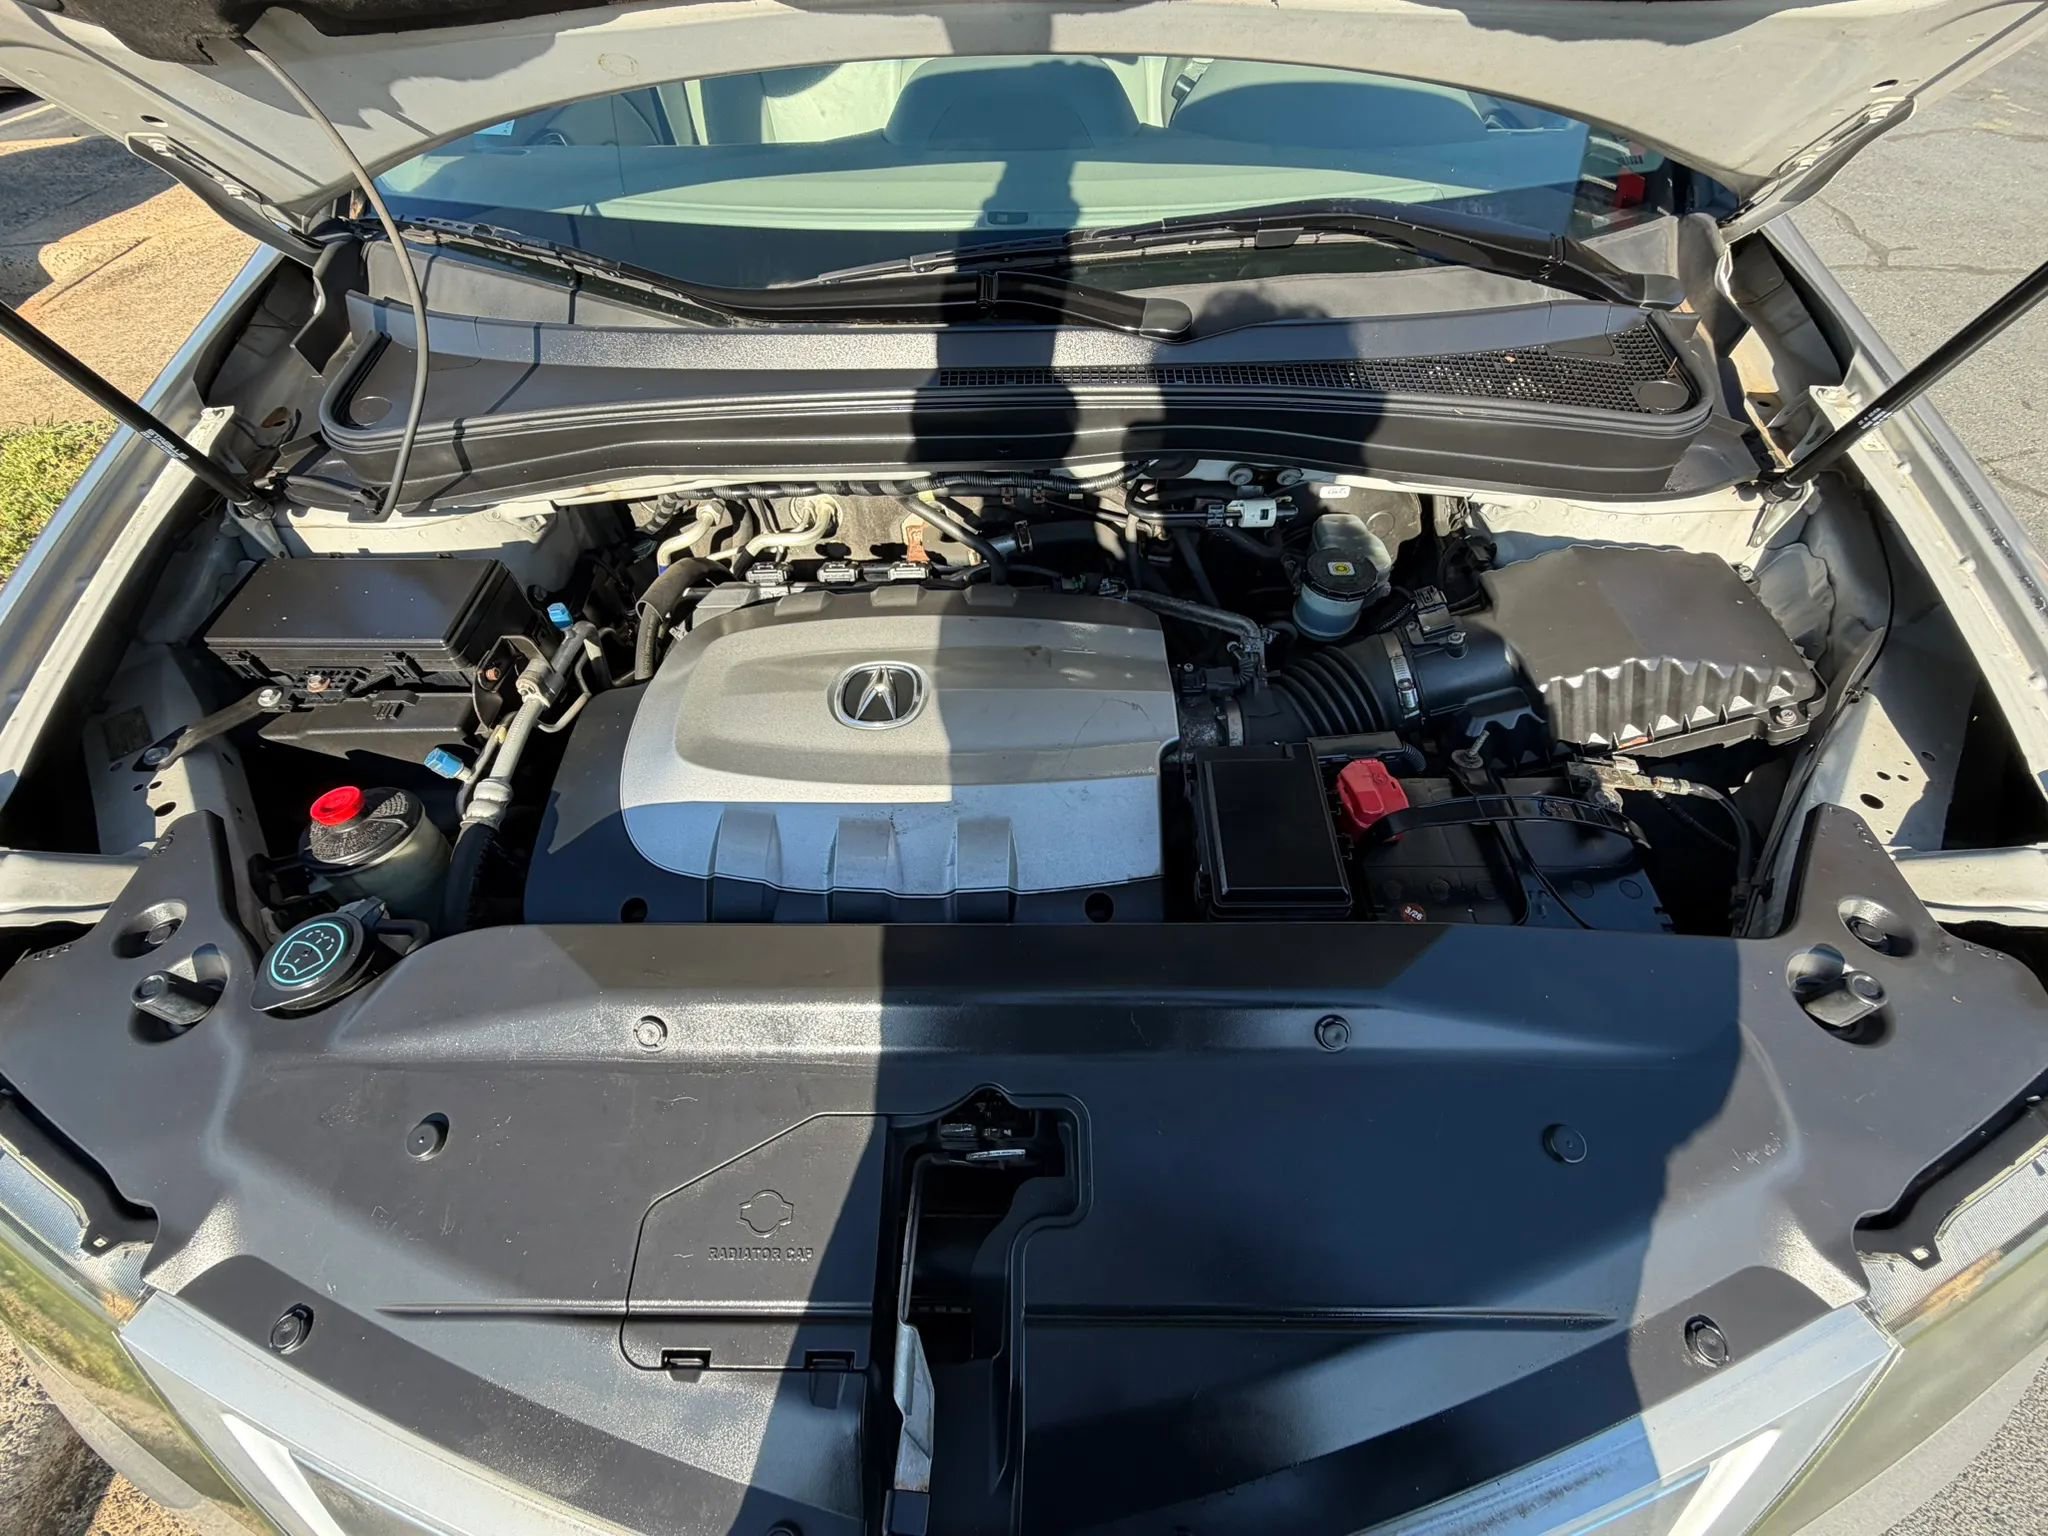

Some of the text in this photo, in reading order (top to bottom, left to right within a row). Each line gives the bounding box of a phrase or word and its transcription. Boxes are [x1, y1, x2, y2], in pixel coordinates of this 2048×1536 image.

[1405, 906, 1423, 920] 3/26
[708, 1247, 814, 1261] RADIATOR CAP
